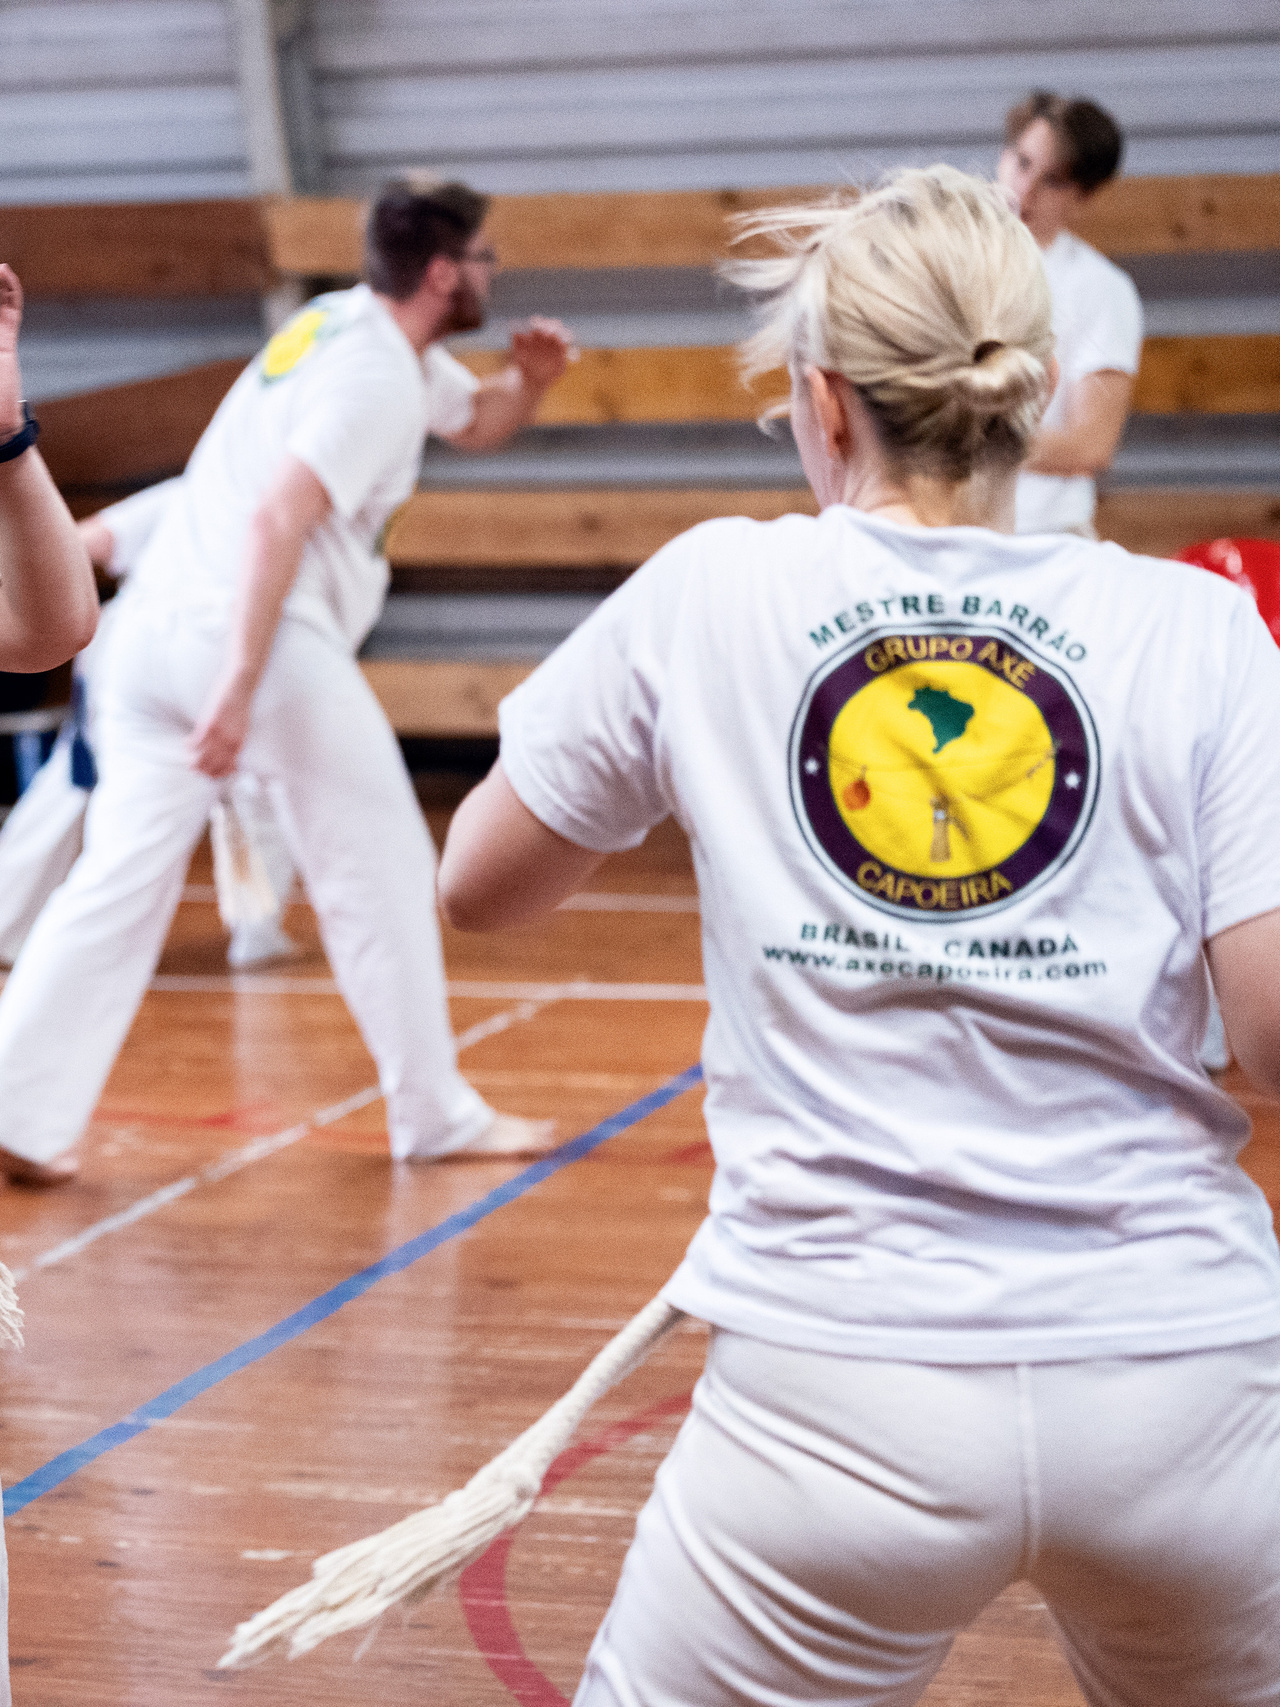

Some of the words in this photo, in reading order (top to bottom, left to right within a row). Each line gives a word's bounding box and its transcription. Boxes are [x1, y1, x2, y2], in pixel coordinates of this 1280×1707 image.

[808, 593, 946, 651] MESTRE
[864, 635, 974, 673] GRUPO
[857, 861, 1014, 909] CAPOEIRA
[799, 922, 911, 953] BRASIL
[761, 943, 1108, 983] www.axecapoeira.com
